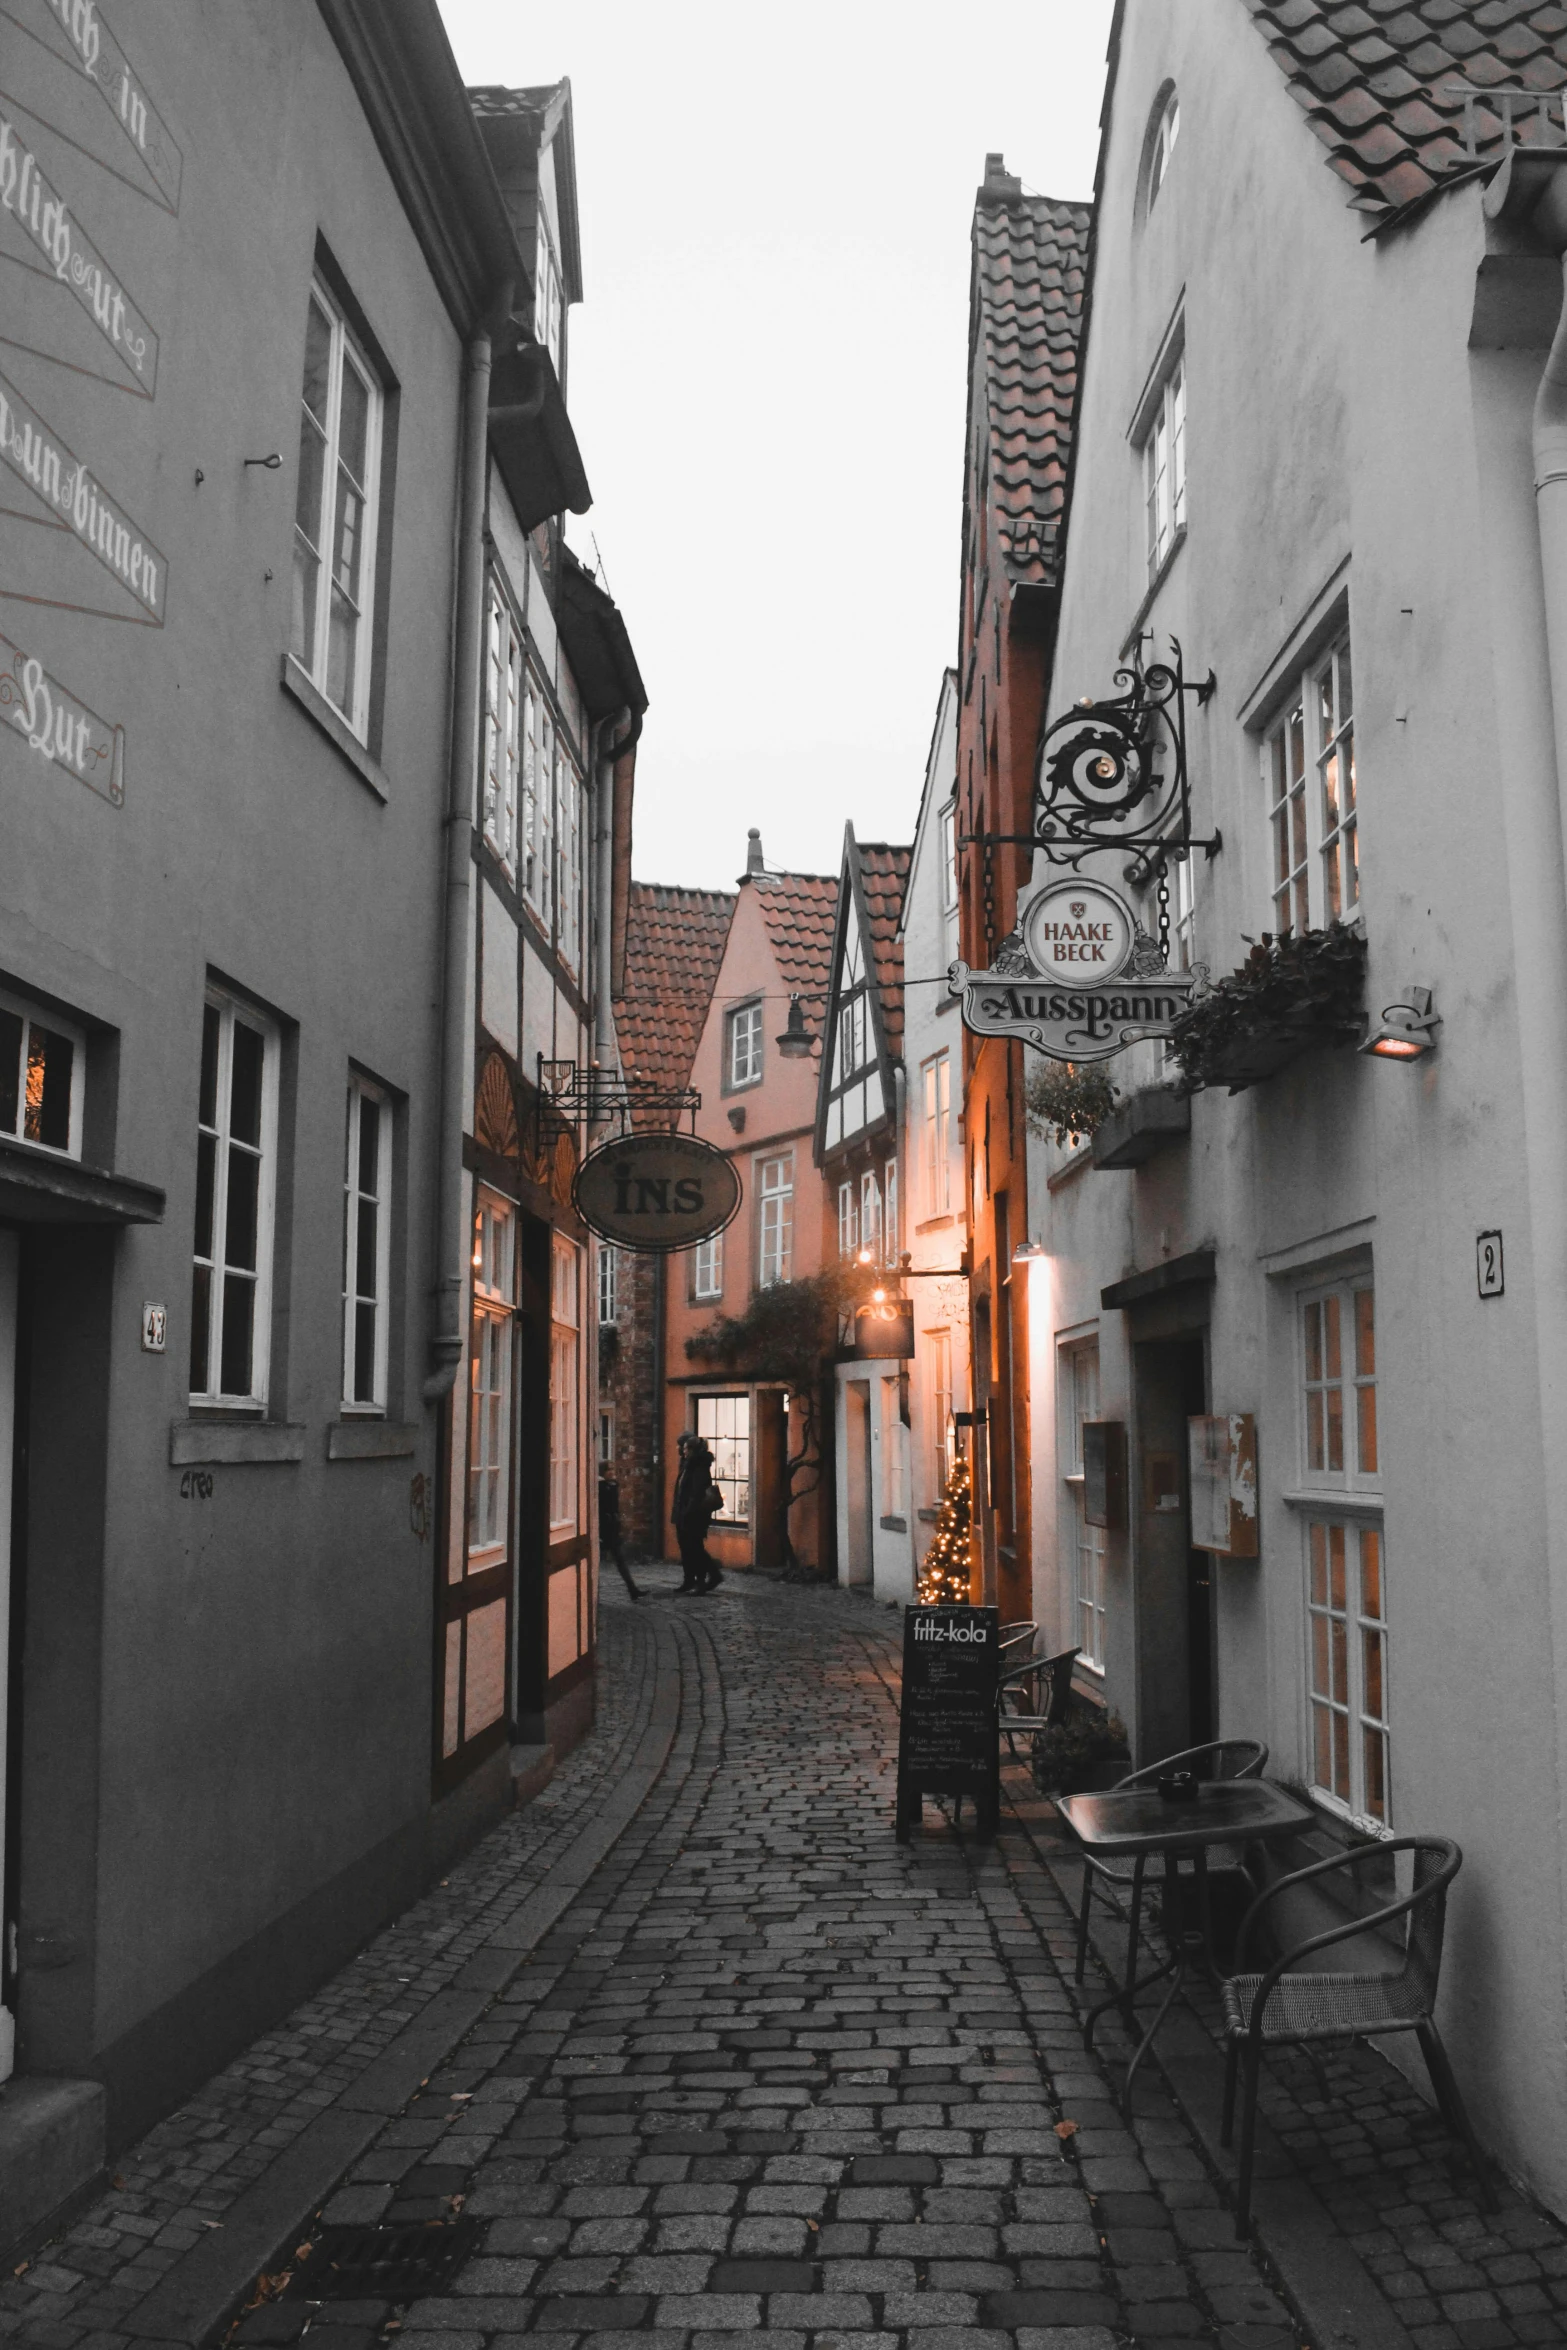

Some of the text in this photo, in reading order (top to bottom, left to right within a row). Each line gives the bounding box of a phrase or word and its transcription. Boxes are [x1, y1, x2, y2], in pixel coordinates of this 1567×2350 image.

[121, 66, 147, 149] in
[73, 463, 157, 605] binnen
[1043, 922, 1114, 942] HAAKE
[1053, 943, 1107, 962] BECK
[981, 987, 1178, 1045] Ausspann
[1484, 1244, 1495, 1285] 2
[147, 1310, 165, 1344] 43
[913, 1617, 987, 1643] fritz-kola
